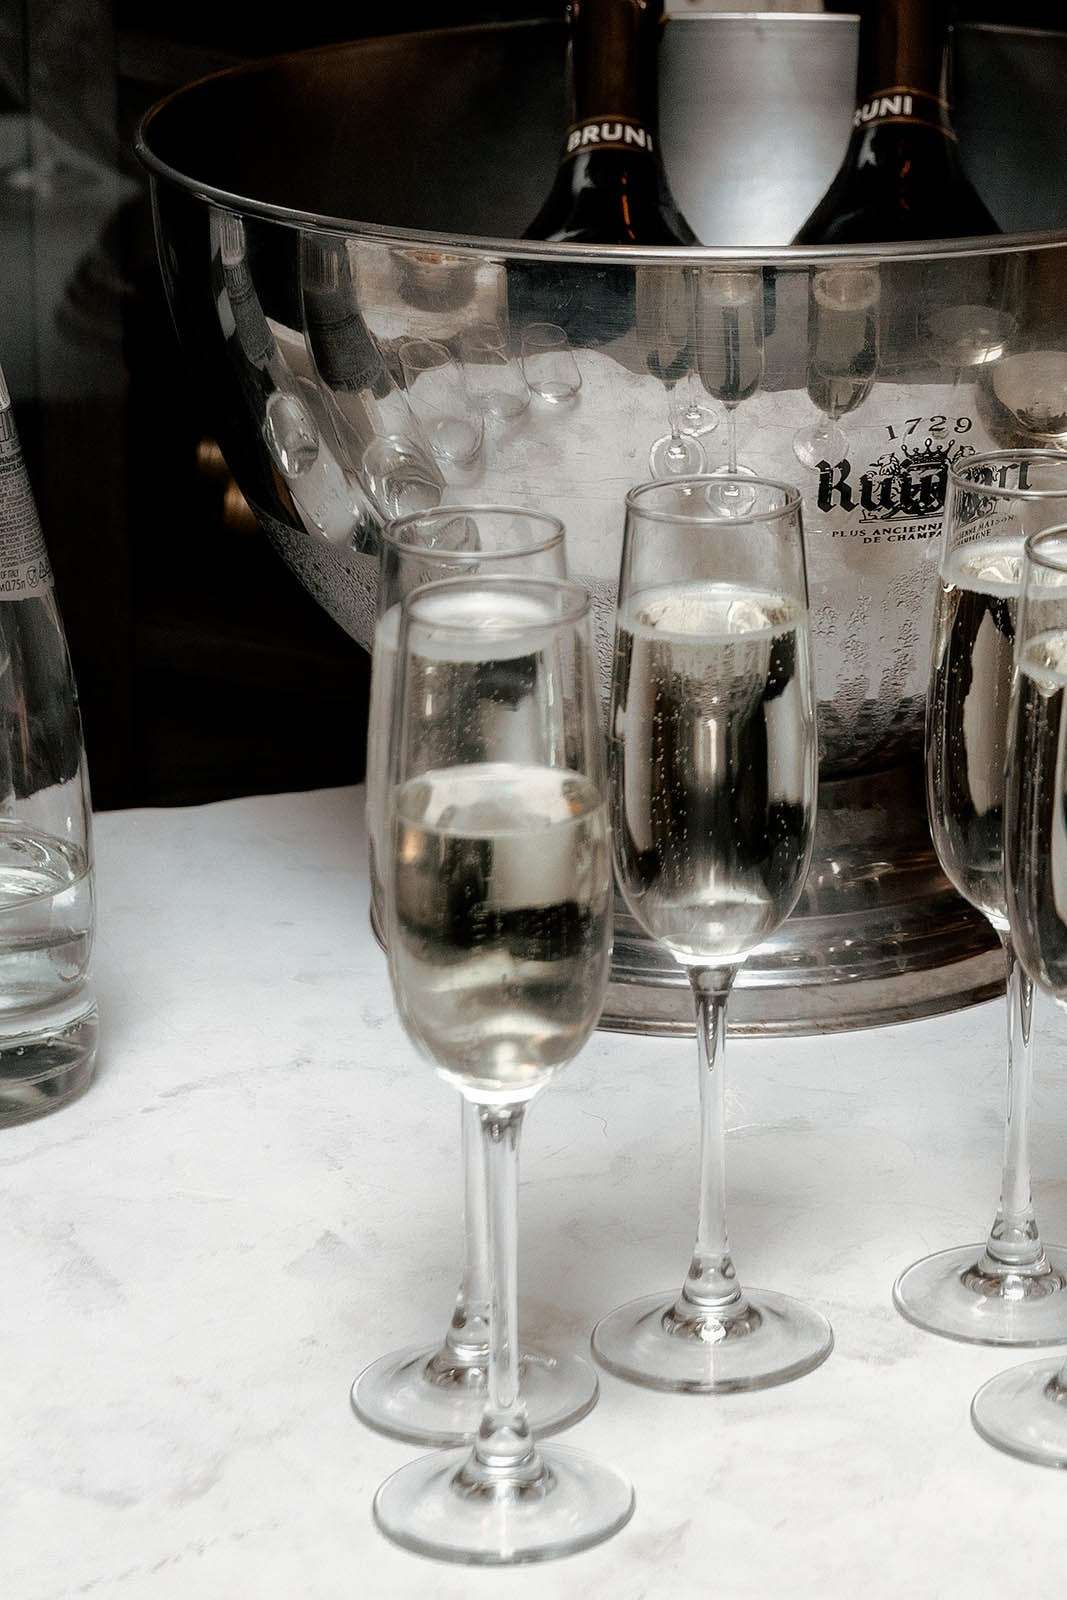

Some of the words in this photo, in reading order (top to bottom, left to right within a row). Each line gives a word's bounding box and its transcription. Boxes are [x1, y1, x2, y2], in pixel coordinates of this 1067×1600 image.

[566, 123, 653, 152] BRUNI
[886, 415, 972, 442] 1729
[832, 529, 866, 537] PLUS
